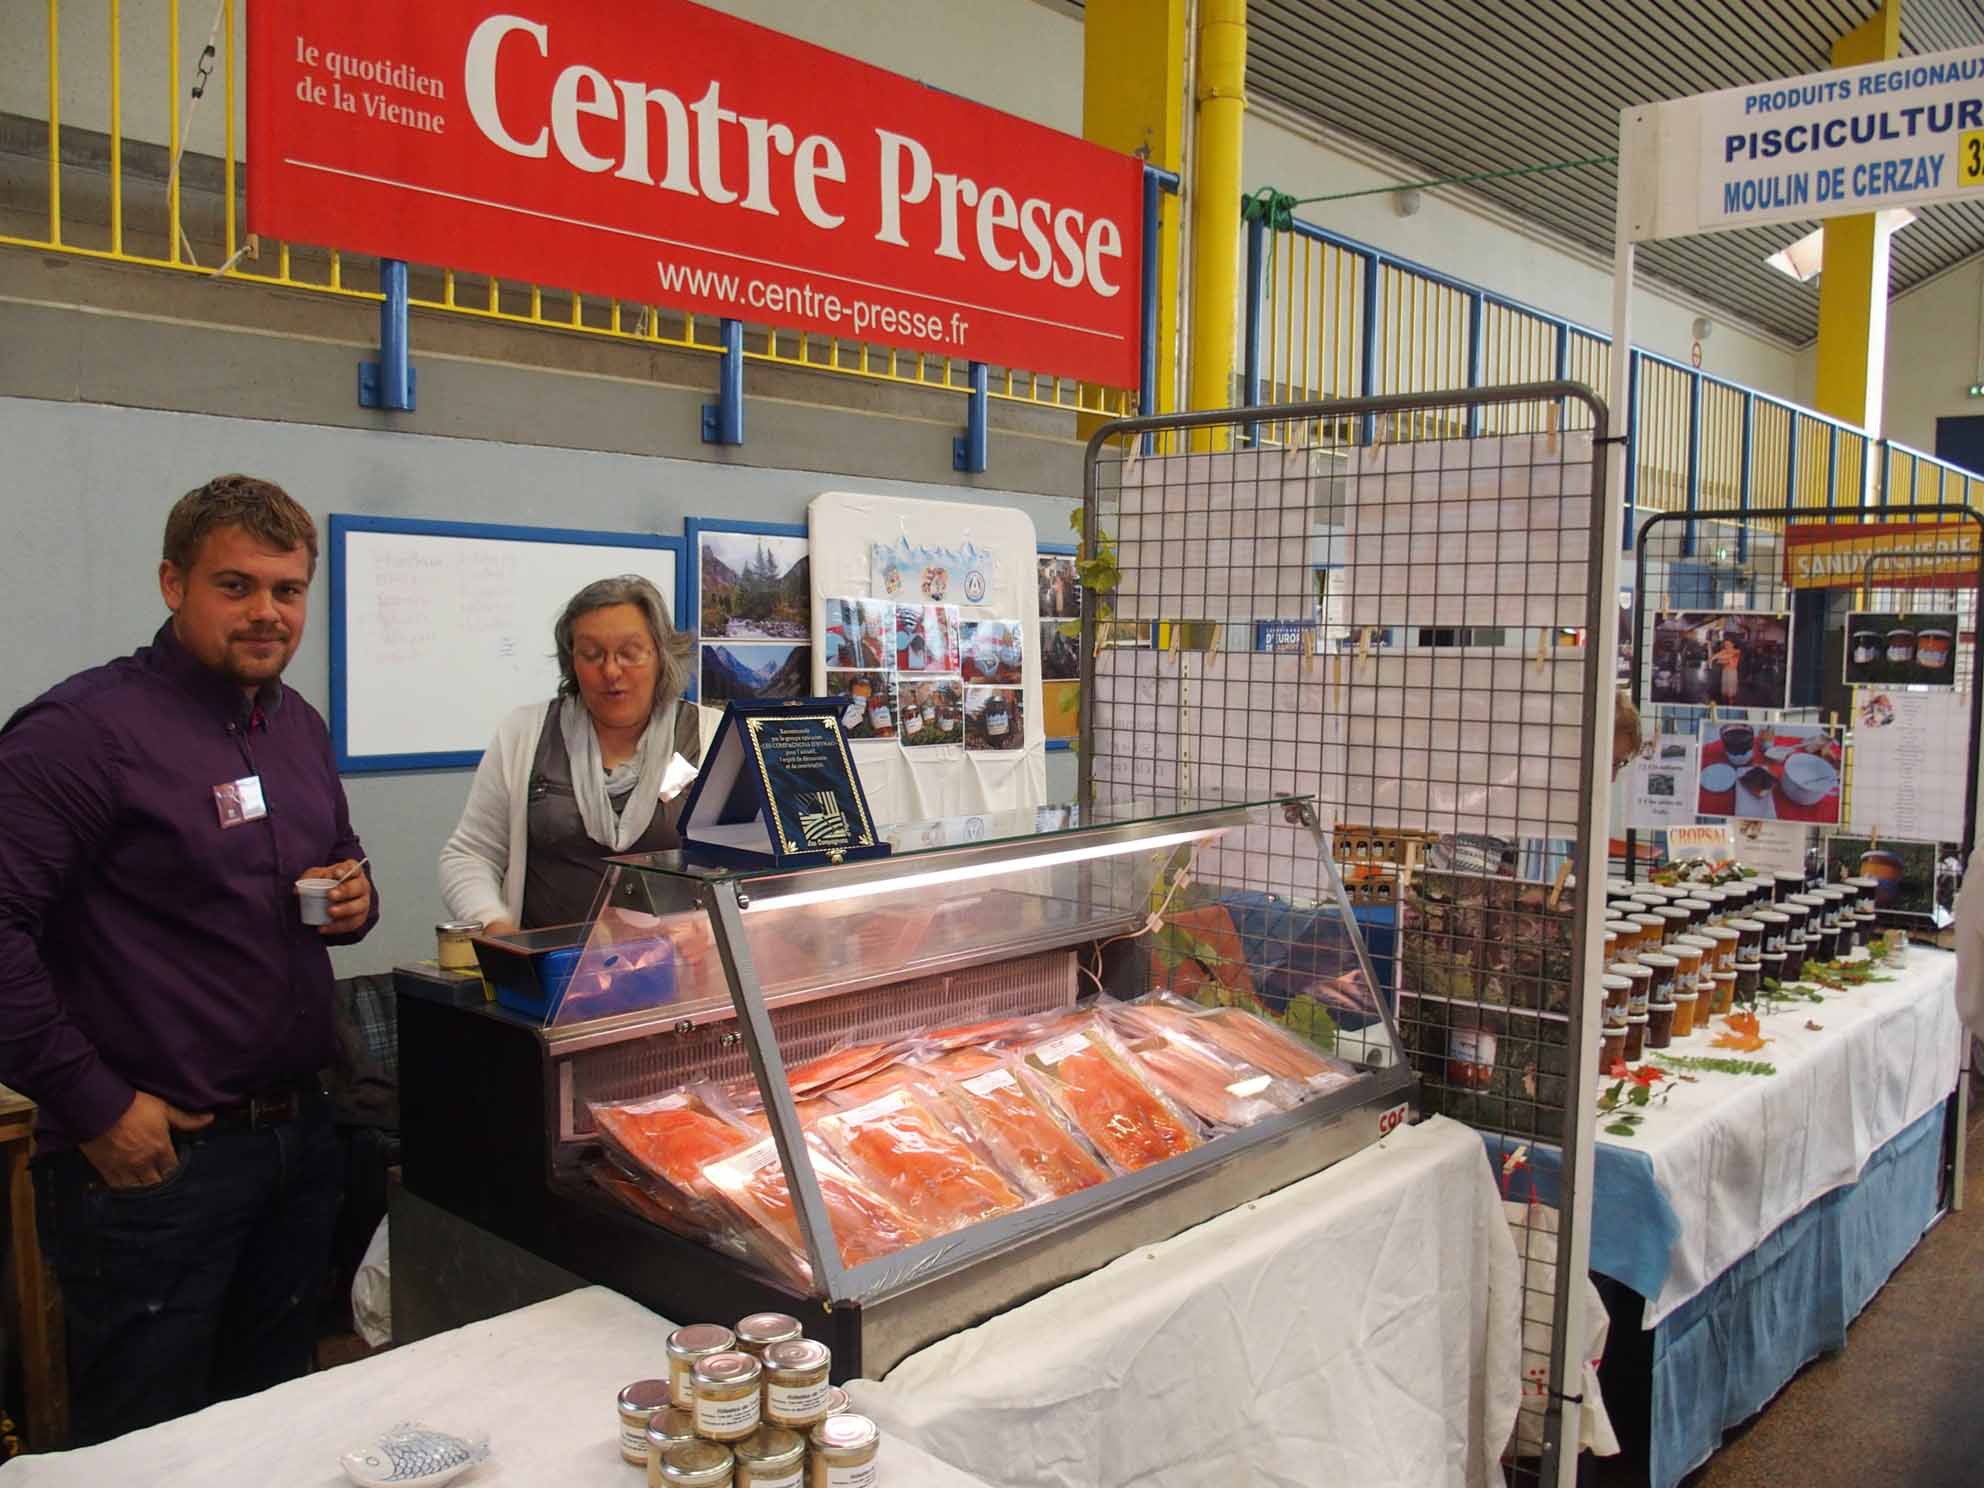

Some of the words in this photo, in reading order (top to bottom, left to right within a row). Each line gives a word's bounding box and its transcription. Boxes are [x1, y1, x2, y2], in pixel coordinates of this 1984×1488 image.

[296, 36, 319, 67] le
[324, 51, 445, 100] quotidien
[1745, 79, 1851, 114] PRODUITS
[296, 76, 327, 106] de
[333, 84, 357, 113] la
[362, 92, 445, 134] Vienne
[464, 14, 848, 230] Centre
[874, 127, 1124, 299] Presse
[1724, 172, 1809, 213] MOULIN
[1816, 167, 1845, 203] DE
[1852, 153, 1945, 198] CERZAY
[1968, 138, 1984, 178] 3
[656, 260, 970, 346] www.centre-presse.fr
